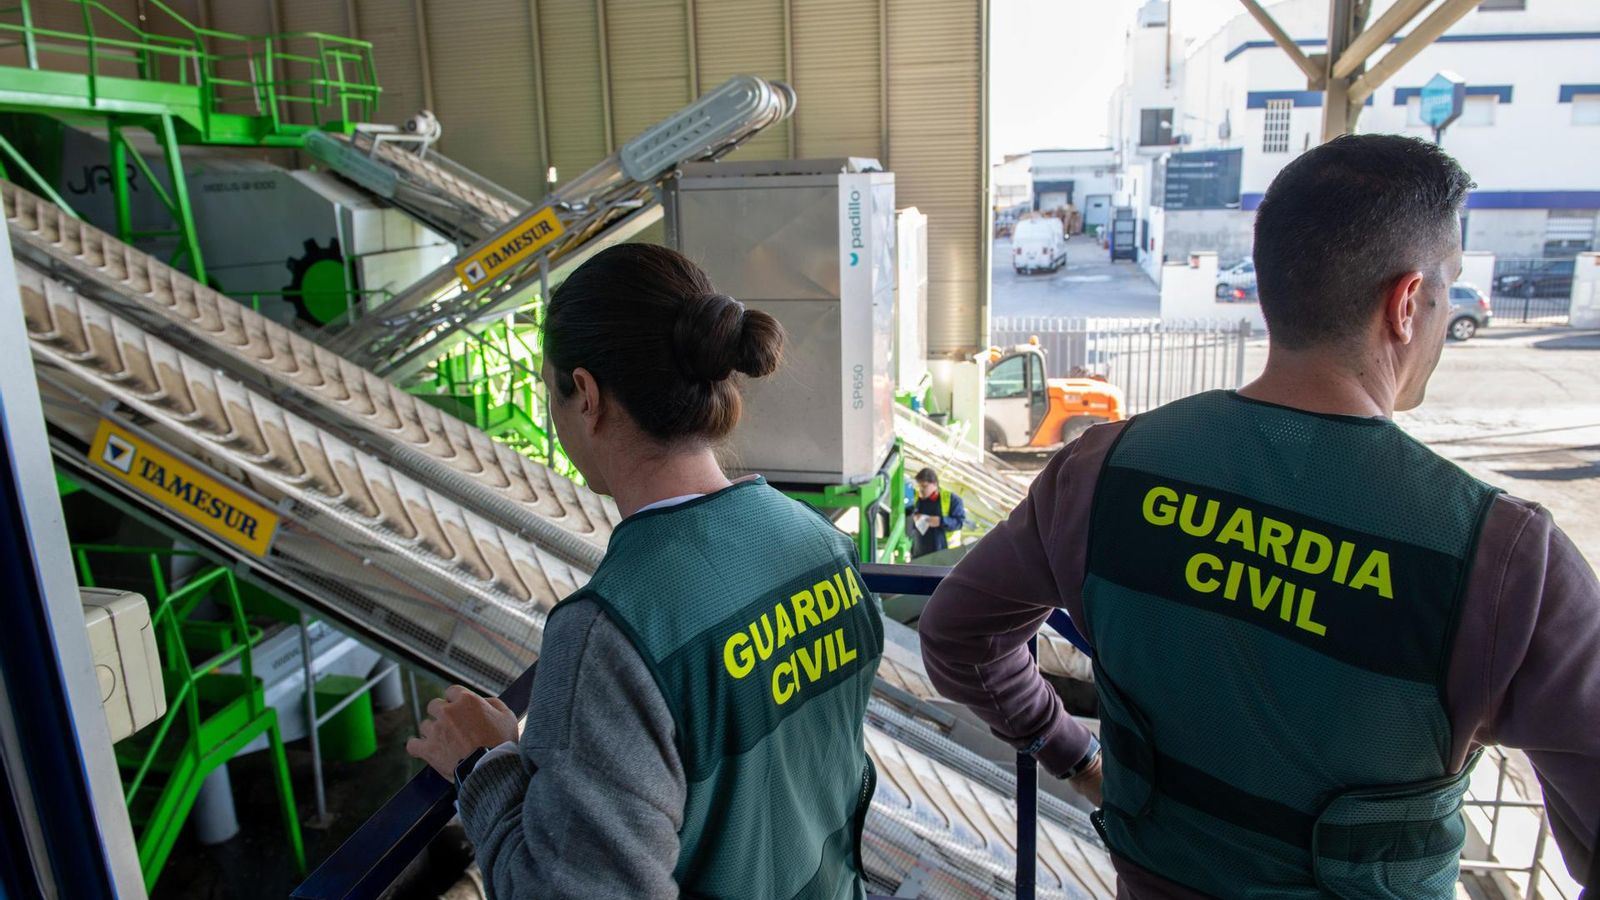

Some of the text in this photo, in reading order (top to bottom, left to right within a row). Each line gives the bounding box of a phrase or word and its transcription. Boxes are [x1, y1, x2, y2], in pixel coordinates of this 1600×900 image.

[483, 220, 553, 269] TAMESUR
[848, 190, 864, 249] padillo
[853, 364, 864, 410] SP650
[140, 457, 258, 541] TAMESUR
[1142, 486, 1394, 600] GUARDIA
[723, 566, 864, 679] GUARDIA
[1185, 552, 1327, 637] CIVIL
[771, 628, 857, 705] CIVIL
